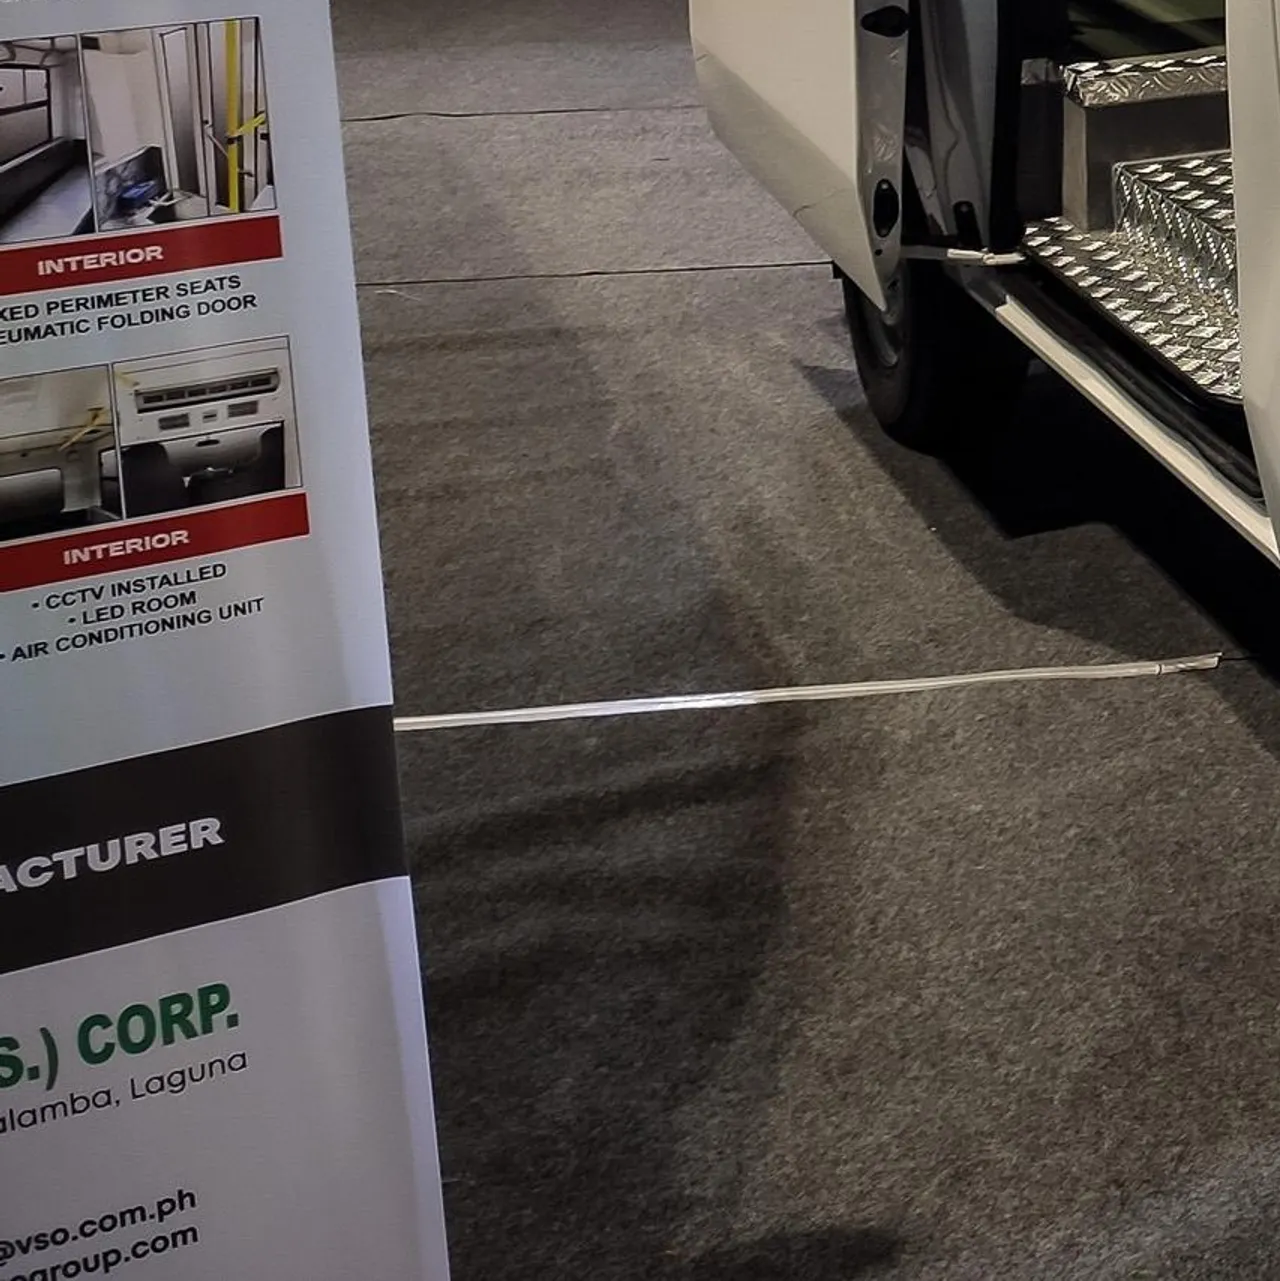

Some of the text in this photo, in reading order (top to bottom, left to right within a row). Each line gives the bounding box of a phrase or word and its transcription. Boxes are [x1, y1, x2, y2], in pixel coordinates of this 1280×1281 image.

[37, 245, 164, 276] INTERIOR
[46, 285, 170, 316] PERIMETER
[176, 275, 242, 297] SEATS
[97, 304, 190, 331] FOLDING
[197, 294, 257, 317] DOOR
[63, 530, 190, 565] INTERIOR
[45, 563, 227, 610] CCTV INSTALLED
[82, 590, 197, 625] LED ROOM
[11, 597, 266, 662] AIR CONDITIONING UNIT
[77, 982, 239, 1066] CORP.
[130, 1052, 248, 1101] Laguna
